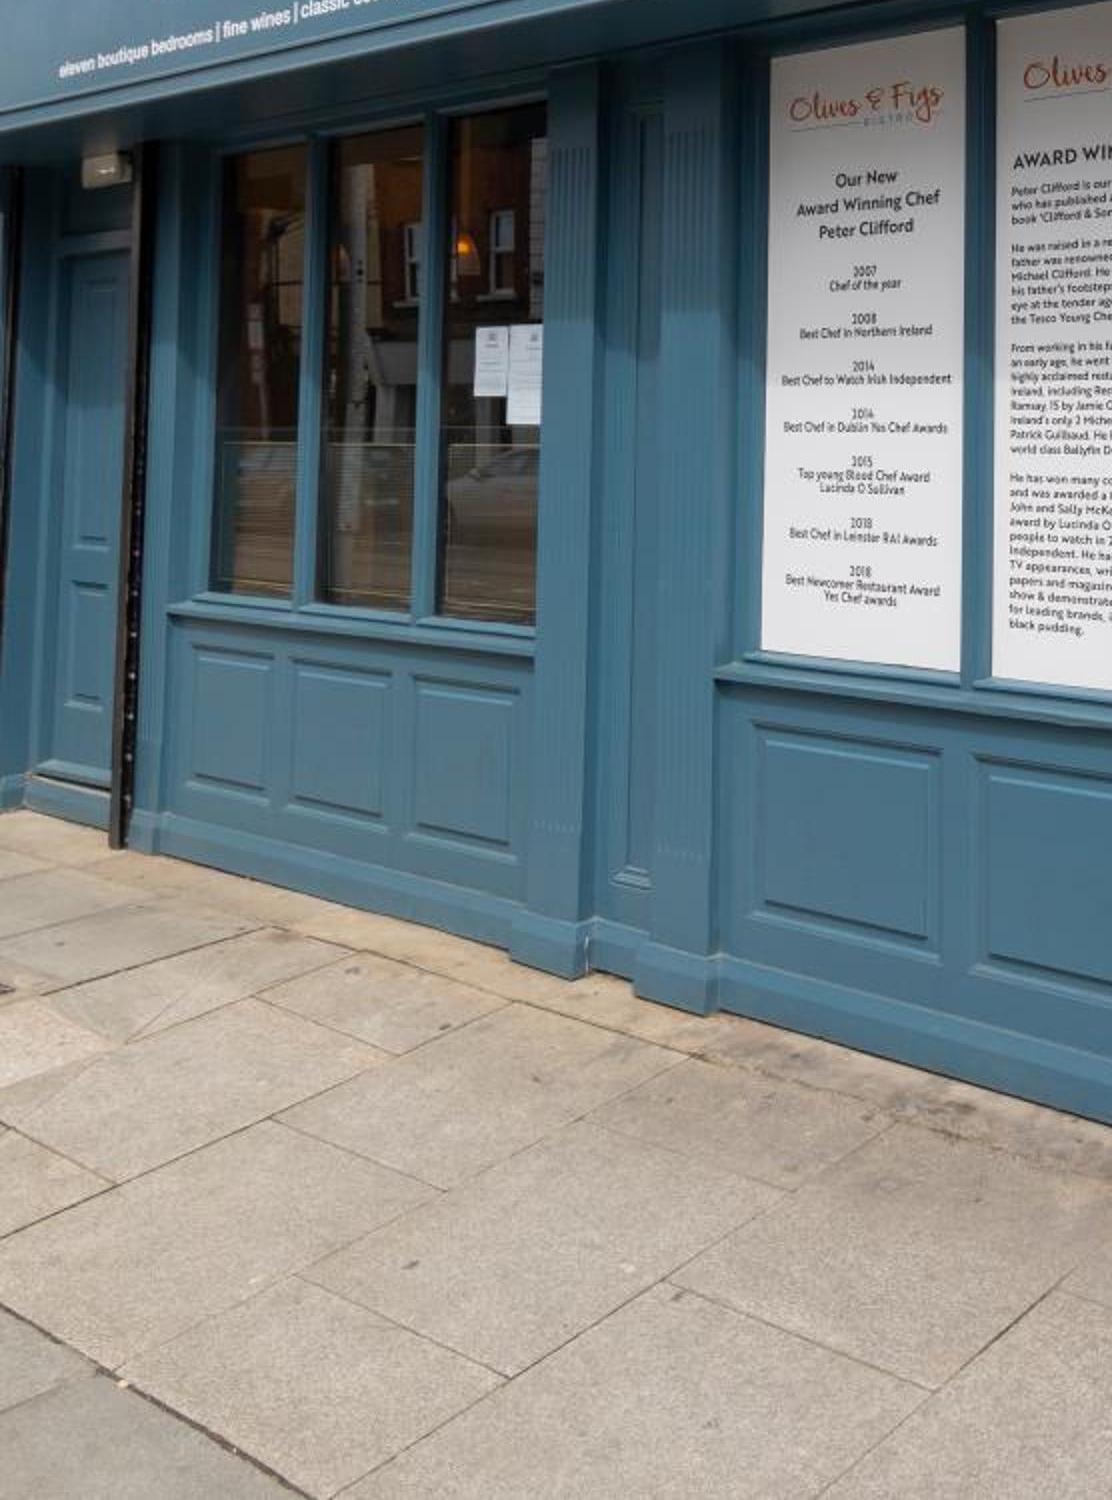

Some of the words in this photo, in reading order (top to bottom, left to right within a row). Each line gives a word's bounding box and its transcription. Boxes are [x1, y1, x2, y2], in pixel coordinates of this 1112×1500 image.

[58, 53, 96, 79] eleven
[97, 43, 149, 71] boutique
[151, 29, 213, 56] bedrooms
[222, 19, 248, 39] fine
[251, 11, 291, 32] wines
[1013, 148, 1077, 170] AWARD
[835, 173, 861, 188] Our
[867, 171, 897, 184] New
[797, 200, 839, 216] Award
[843, 196, 902, 211] Winning
[906, 190, 940, 207] Chef
[819, 225, 855, 239] Peter
[859, 219, 914, 236] Clifford
